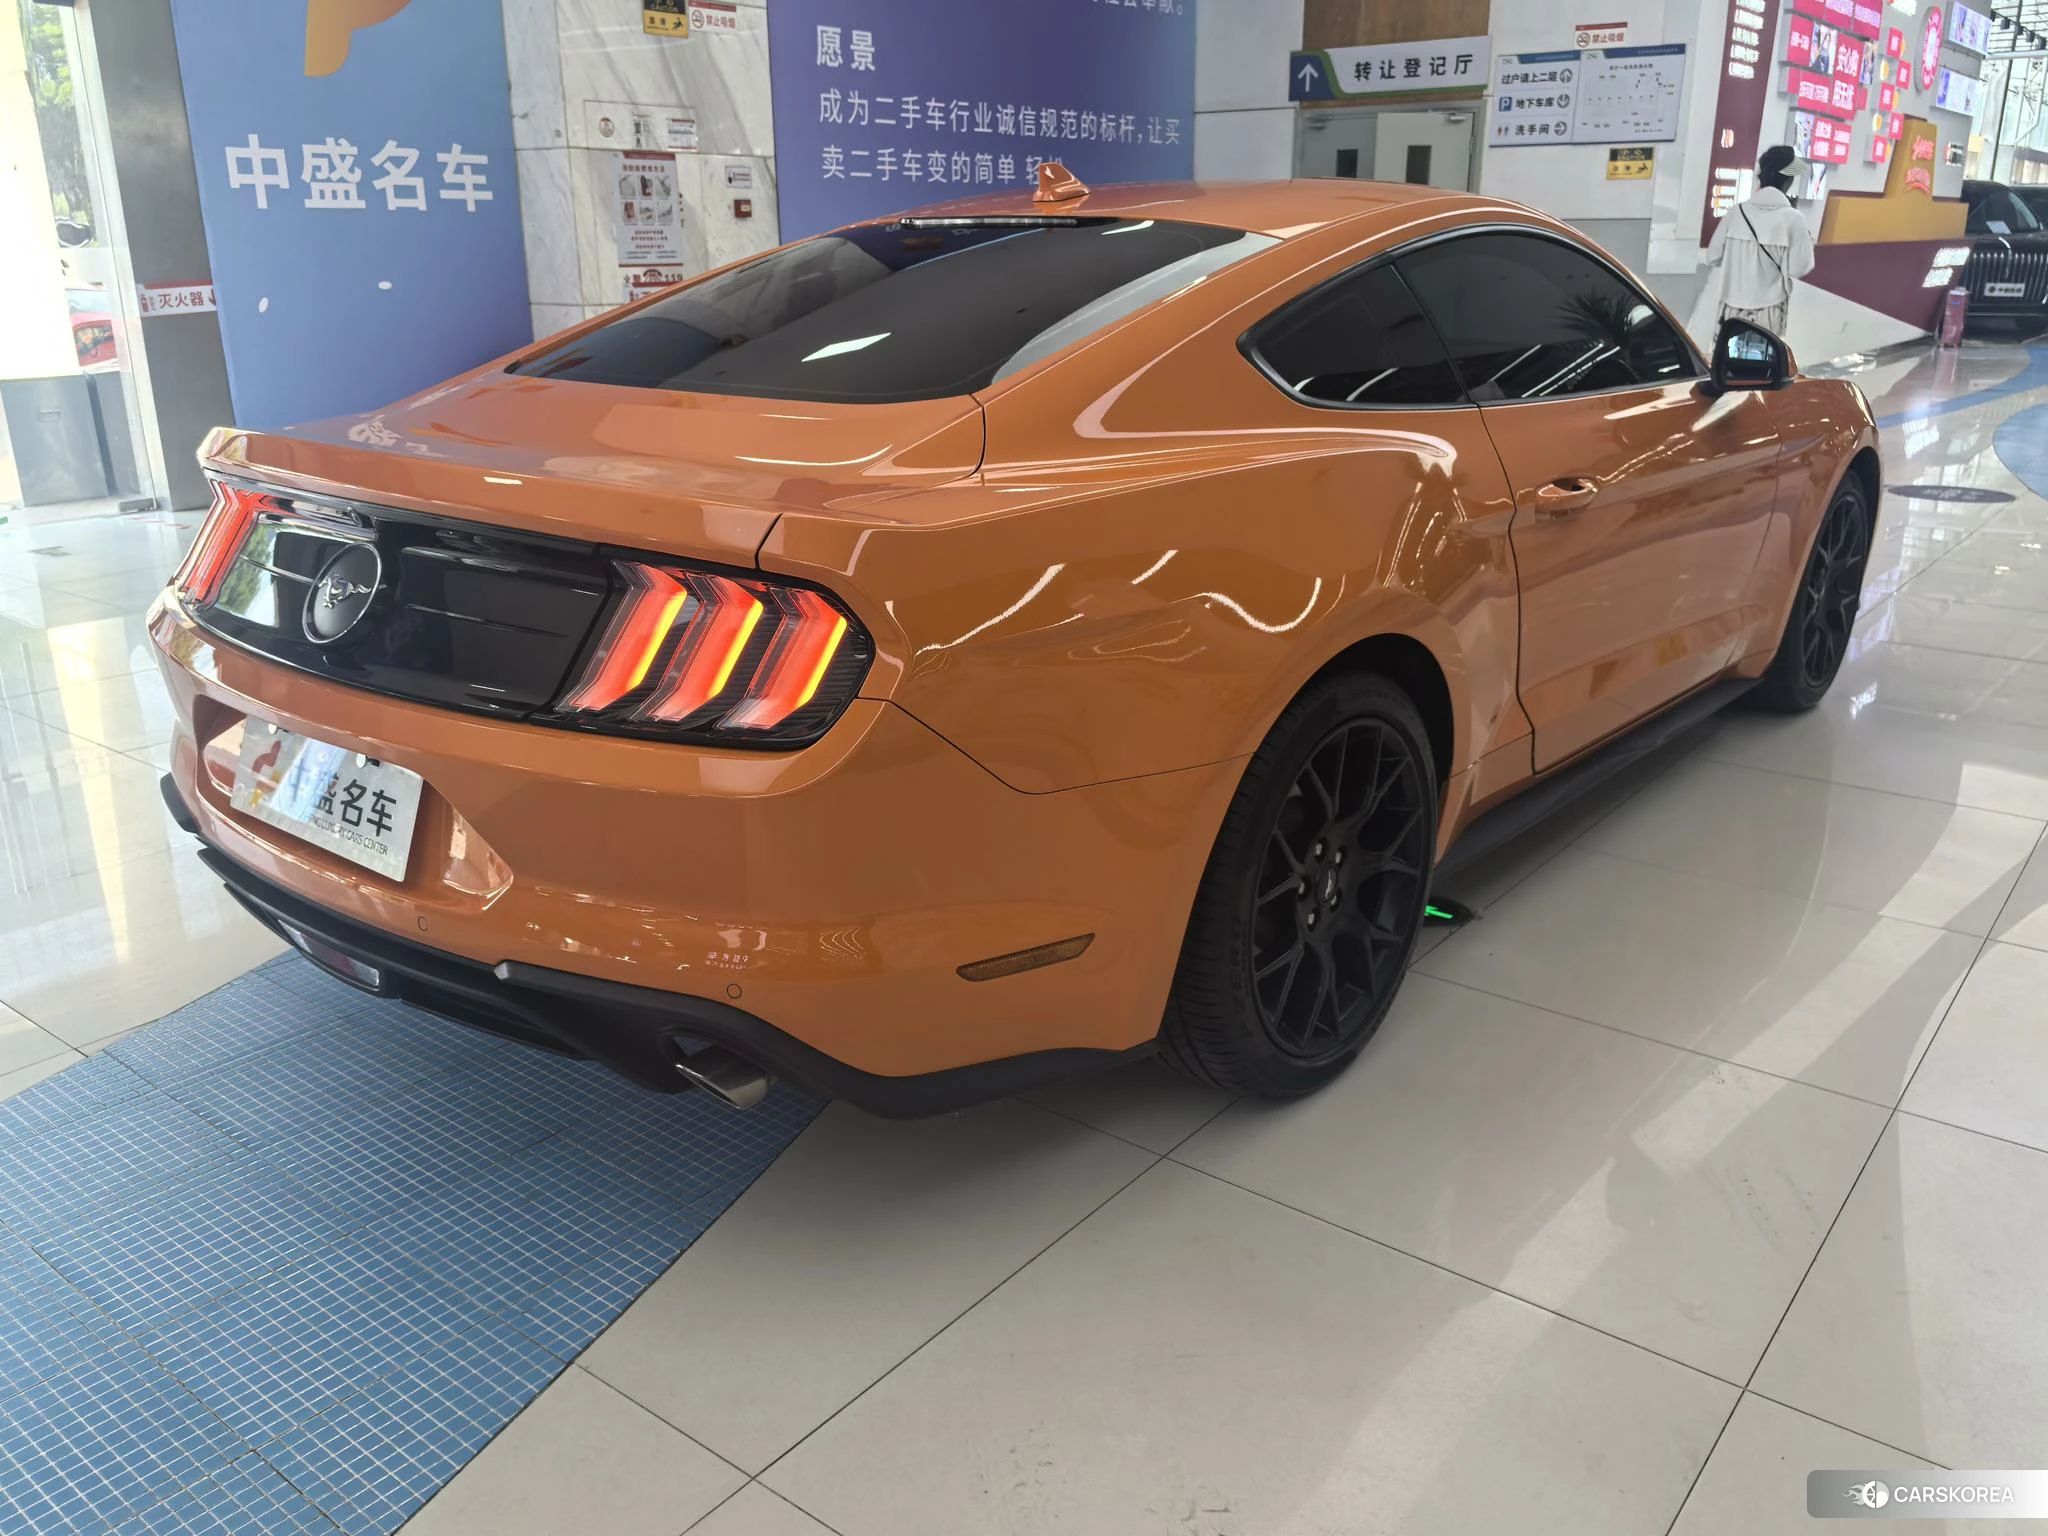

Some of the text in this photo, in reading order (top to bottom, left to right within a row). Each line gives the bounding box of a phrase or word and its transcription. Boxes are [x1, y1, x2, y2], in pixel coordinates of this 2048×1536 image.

[1592, 32, 1624, 44] 禁止吸烟
[816, 25, 876, 71] 愿景
[1354, 53, 1473, 82] 转让登记厅
[1501, 71, 1558, 85] 过户请上二层
[1515, 96, 1555, 109] 地下车库
[1514, 124, 1550, 136] 洗手间
[225, 133, 494, 212] 中盛名车
[159, 291, 204, 309] 灭火器
[363, 837, 389, 856] CENTER
